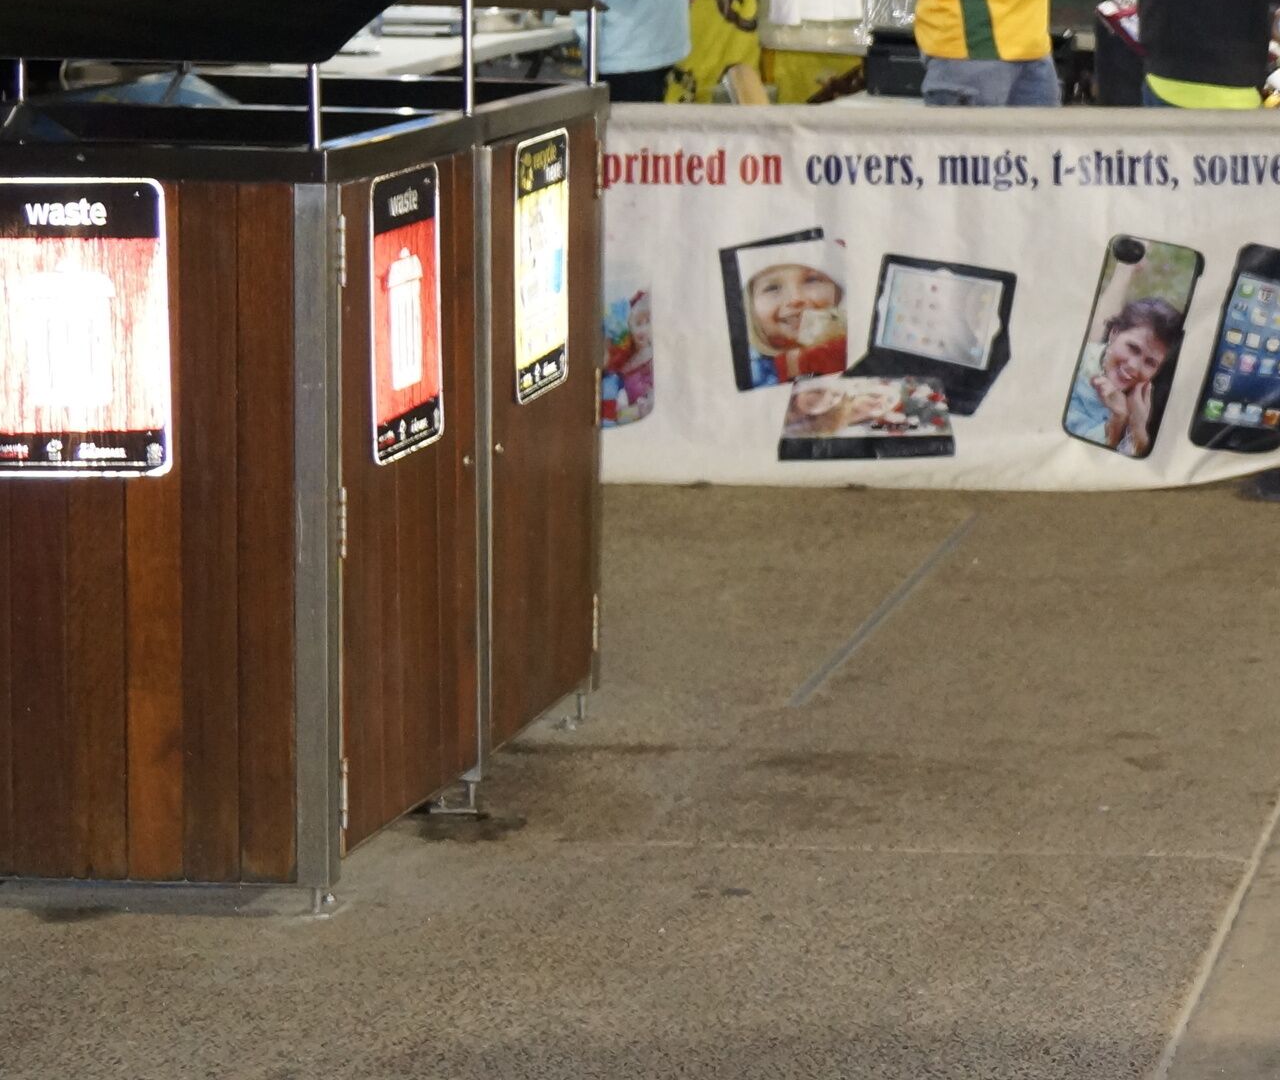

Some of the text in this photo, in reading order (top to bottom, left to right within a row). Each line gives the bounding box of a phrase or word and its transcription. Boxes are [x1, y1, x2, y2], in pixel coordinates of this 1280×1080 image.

[602, 147, 727, 189] printed
[740, 153, 783, 186] on
[805, 152, 925, 191] covers,
[937, 148, 1040, 192] mugs,
[1052, 148, 1180, 191] t-shirts,
[25, 197, 108, 227] waste
[387, 186, 419, 217] waste
